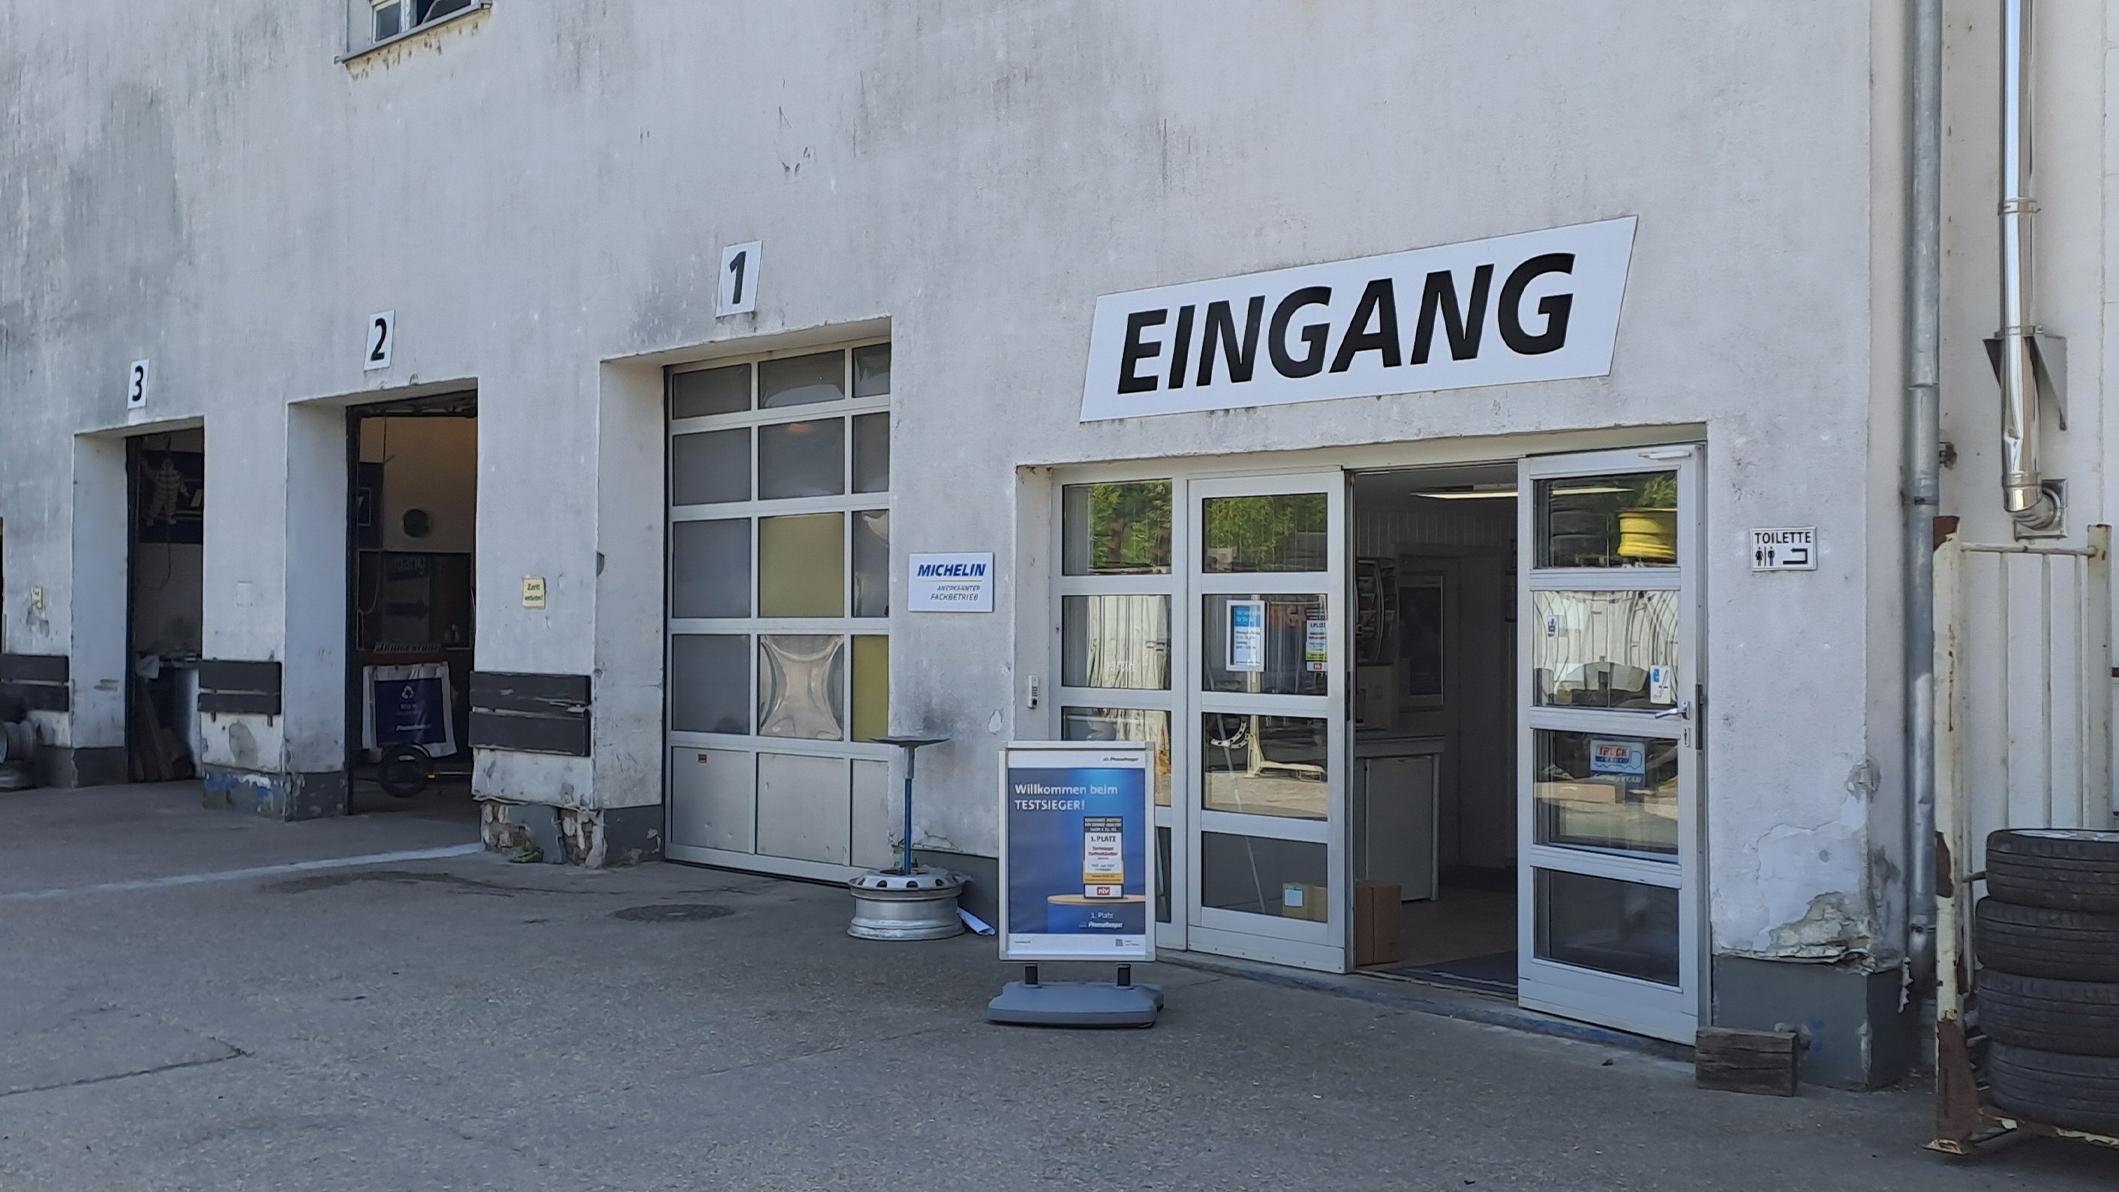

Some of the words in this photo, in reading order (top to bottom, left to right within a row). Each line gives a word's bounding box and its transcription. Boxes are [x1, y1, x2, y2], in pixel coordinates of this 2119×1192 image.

[729, 251, 747, 305] 1
[1117, 252, 1576, 395] EINGANG
[370, 317, 387, 361] 2
[132, 365, 144, 402] 3
[1754, 531, 1811, 545] TOILETTE
[917, 563, 987, 577] MICHELIN
[930, 593, 979, 601] FACHBETRIEB
[1014, 783, 1087, 795] Willkommen
[1090, 783, 1119, 795] beim
[1014, 799, 1086, 811] TESTSIEGER!
